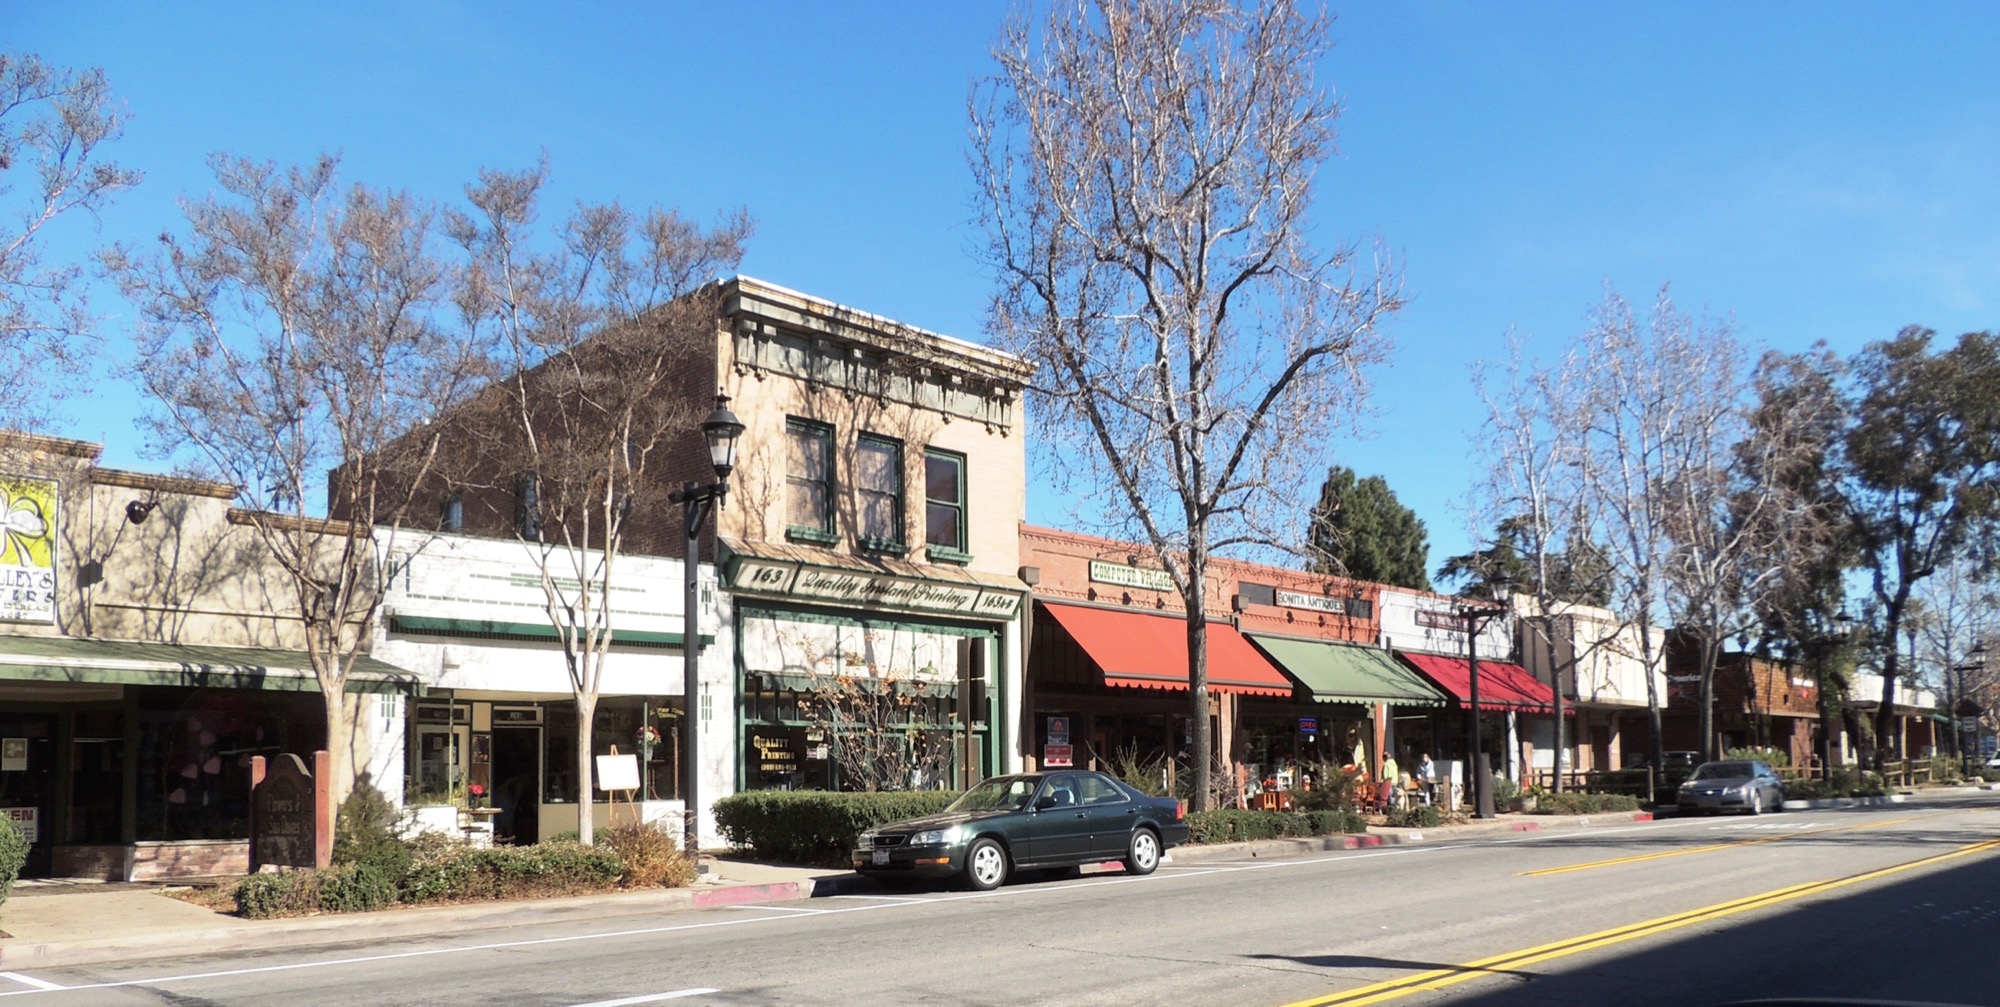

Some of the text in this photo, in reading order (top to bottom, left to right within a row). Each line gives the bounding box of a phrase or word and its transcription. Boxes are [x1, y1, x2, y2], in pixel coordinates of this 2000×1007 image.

[751, 567, 784, 585] 163
[1093, 563, 1137, 583] COMPUTER
[801, 571, 969, 608] Quality Instant Printing
[1277, 592, 1345, 611] BONITA ANTIQUES
